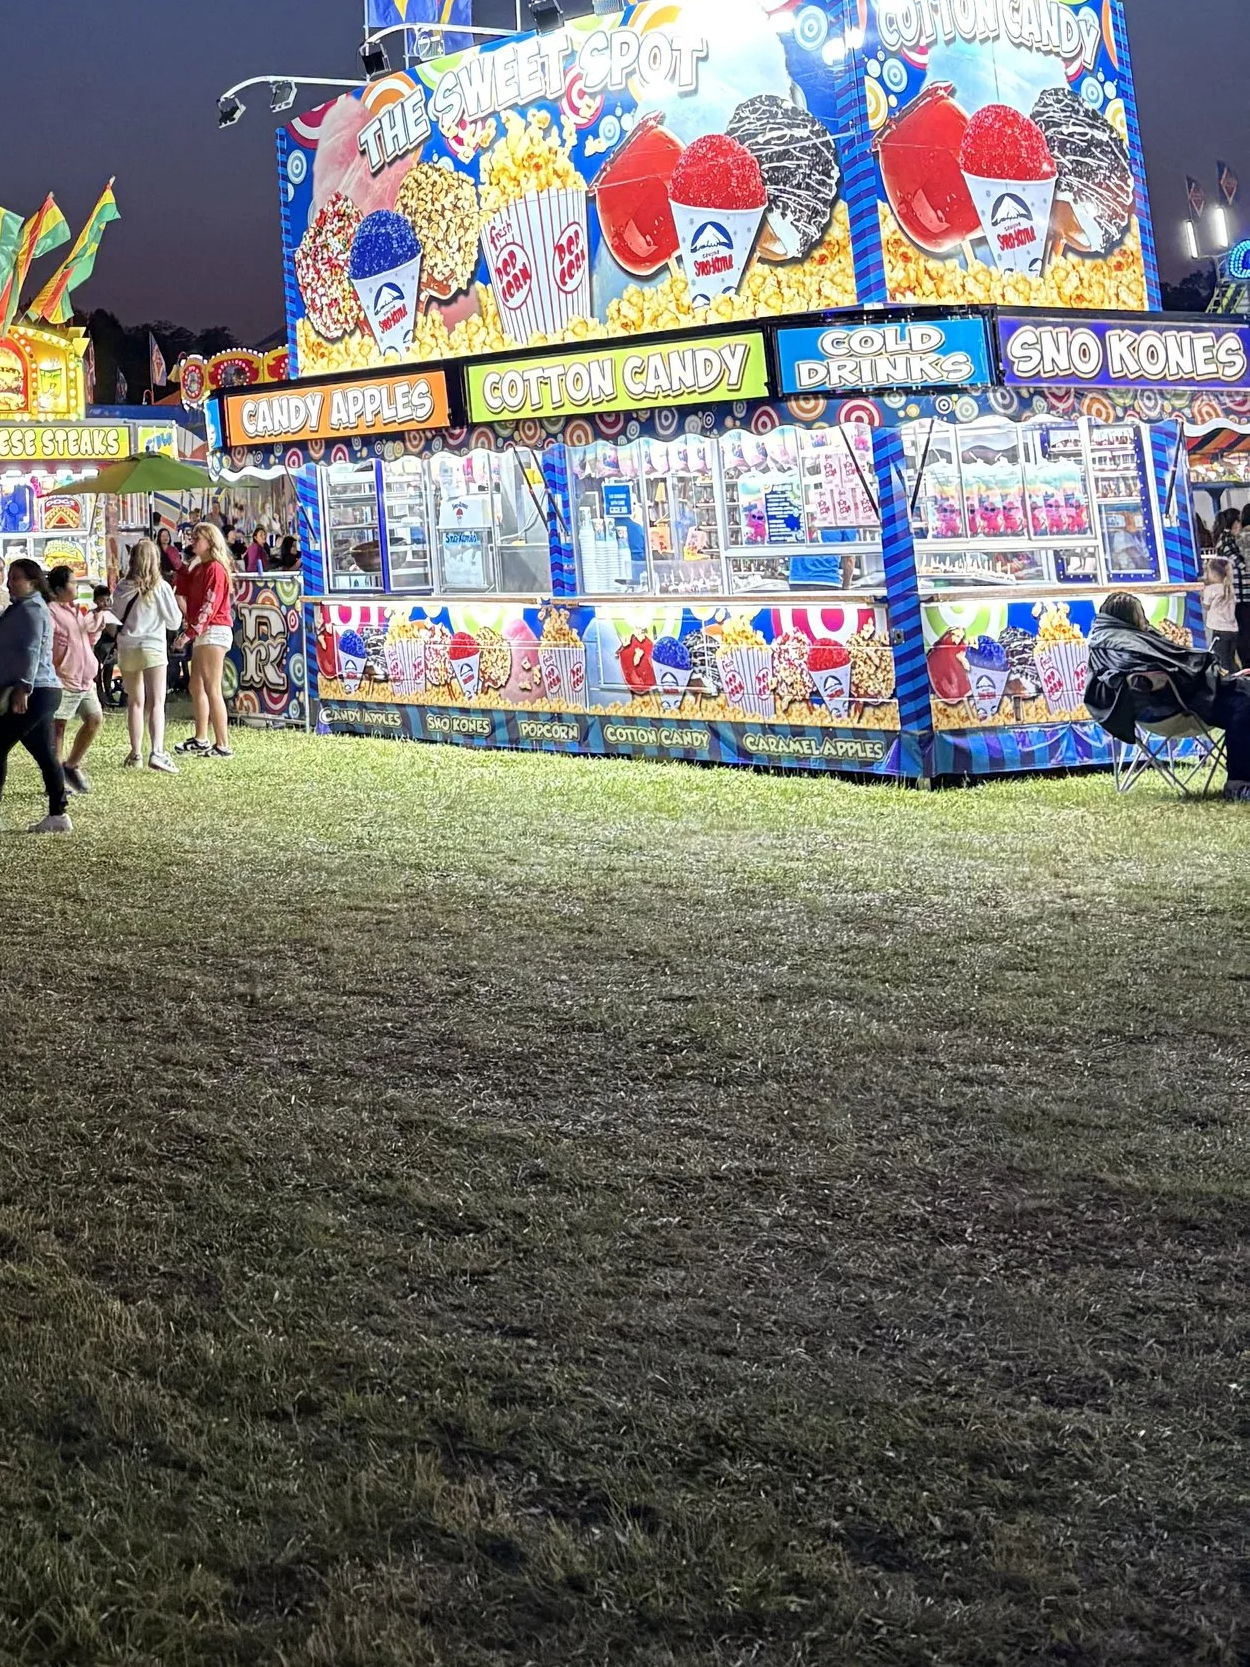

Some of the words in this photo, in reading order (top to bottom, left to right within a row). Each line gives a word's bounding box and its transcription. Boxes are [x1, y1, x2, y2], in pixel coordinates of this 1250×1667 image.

[358, 85, 431, 173] THE
[431, 34, 572, 127] SWEET
[579, 31, 709, 94] SPOT
[489, 220, 516, 251] fresh
[554, 229, 581, 264] POP
[494, 250, 518, 282] POP
[501, 262, 531, 303] CORN
[820, 325, 944, 357] COLD
[1008, 325, 1104, 379] SNO
[1107, 330, 1249, 381] KONES
[483, 359, 616, 412] COTTON
[622, 343, 751, 402] CANDY
[797, 352, 975, 388] DRINKS
[239, 390, 323, 439] CANDY
[329, 378, 435, 430] APPLES
[41, 429, 121, 457] STEAKS
[319, 708, 362, 725] CANDY
[361, 710, 402, 727] APPLES
[426, 714, 450, 733] SNO
[450, 716, 491, 737] KONES
[519, 721, 580, 742] POPCORN
[604, 724, 657, 746] COTTON
[659, 726, 711, 749] CANDY
[742, 733, 821, 757] CARAMEL
[819, 737, 886, 761] APPLES
